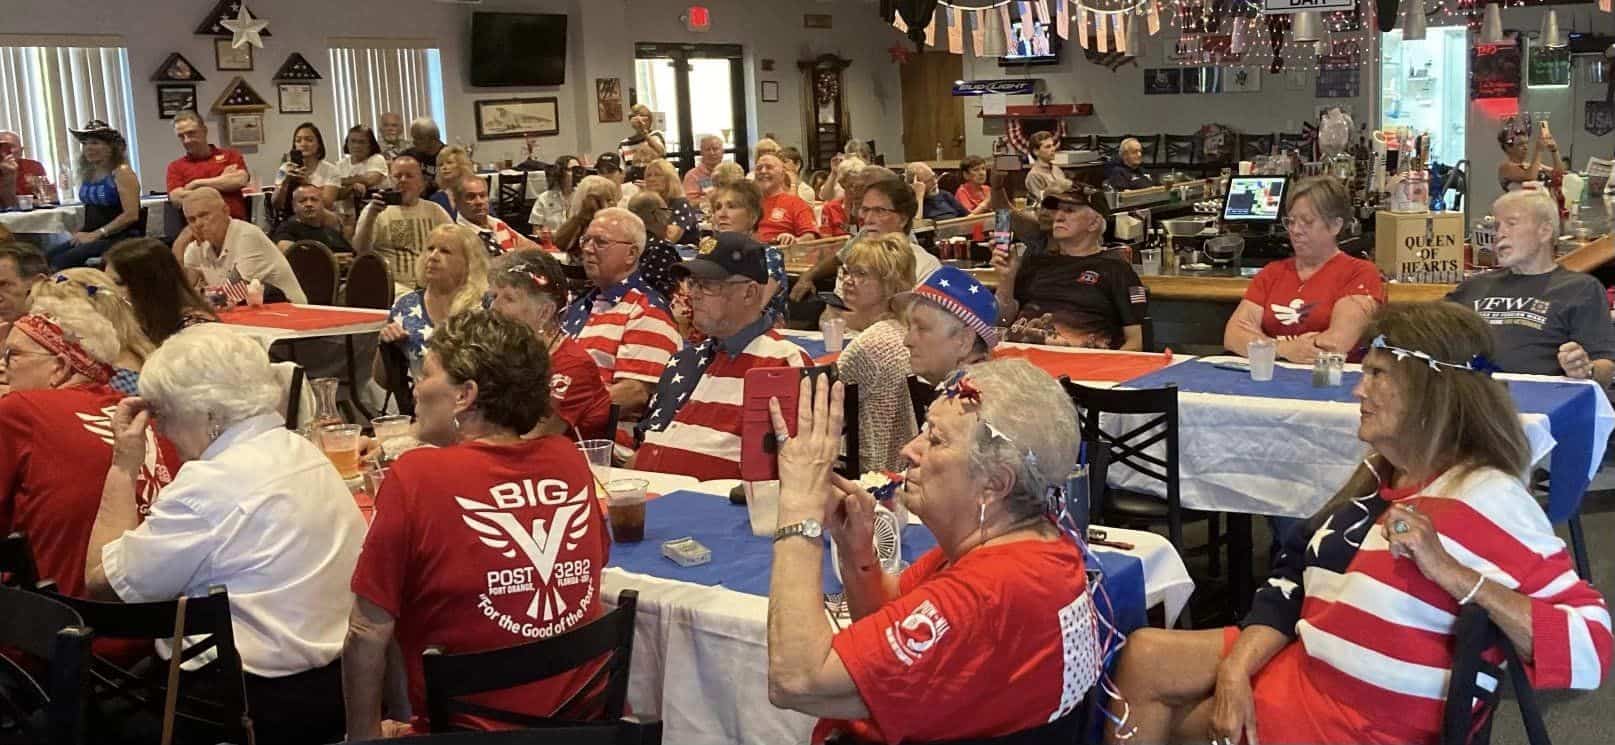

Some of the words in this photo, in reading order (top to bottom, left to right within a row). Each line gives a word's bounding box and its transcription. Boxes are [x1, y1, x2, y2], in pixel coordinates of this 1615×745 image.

[1404, 234, 1456, 250] QUEEN
[1420, 248, 1439, 260] OF
[1402, 259, 1458, 273] HEARTS
[1472, 296, 1534, 312] VFW
[489, 478, 569, 509] BIG
[487, 566, 534, 588] POST
[554, 559, 591, 579] 3282
[499, 612, 521, 634] the
[522, 622, 553, 638] Good
[554, 618, 570, 634] of
[566, 607, 584, 626] the
